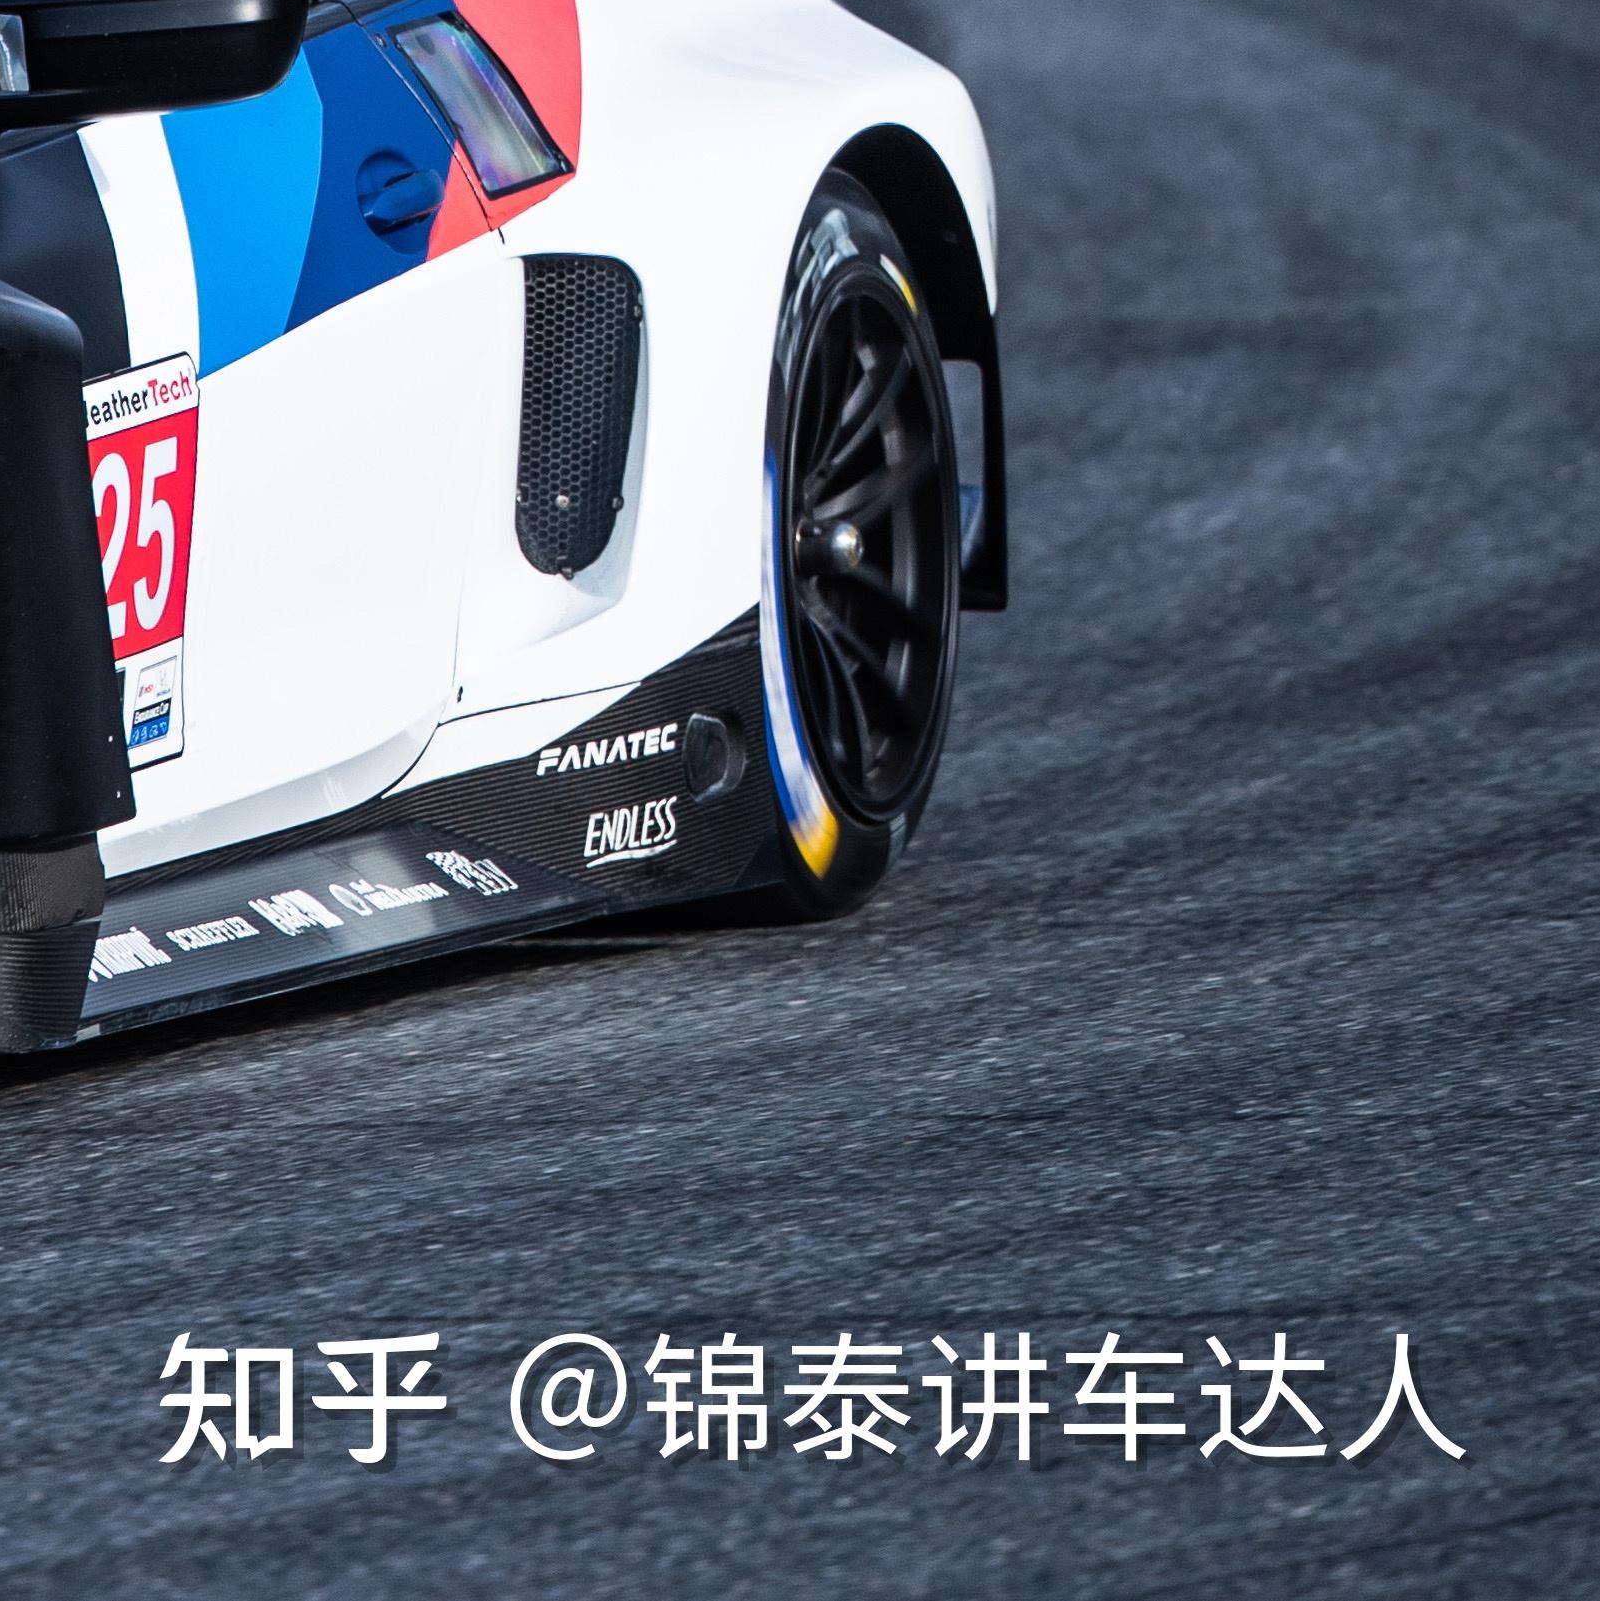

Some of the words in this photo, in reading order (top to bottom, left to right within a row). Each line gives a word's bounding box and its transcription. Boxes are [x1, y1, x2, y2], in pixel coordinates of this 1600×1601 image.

[83, 370, 193, 430] eatherTech
[92, 436, 178, 639] 25
[537, 722, 678, 777] FANATEC
[584, 795, 678, 860] ENDLESS
